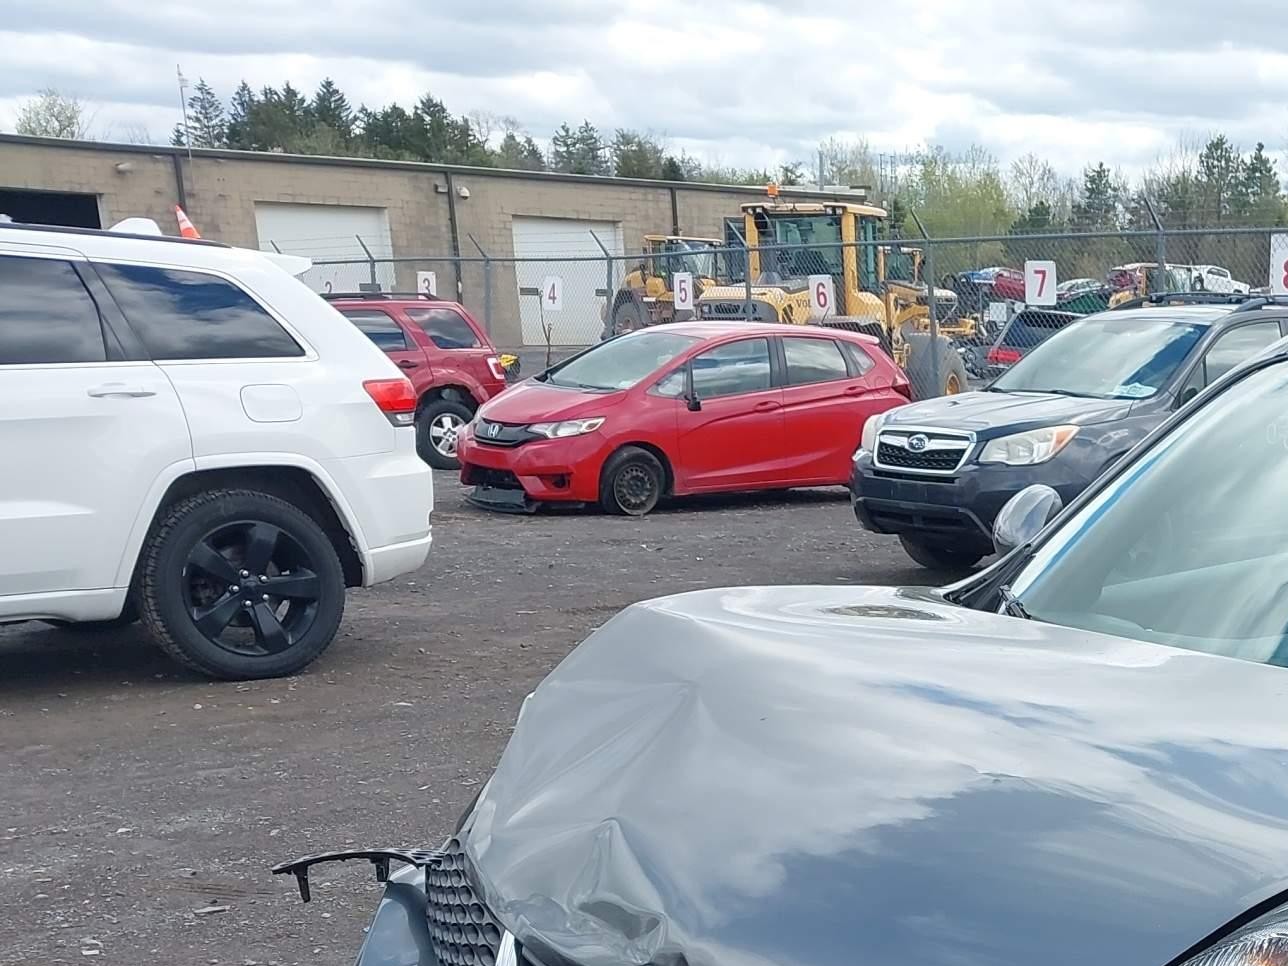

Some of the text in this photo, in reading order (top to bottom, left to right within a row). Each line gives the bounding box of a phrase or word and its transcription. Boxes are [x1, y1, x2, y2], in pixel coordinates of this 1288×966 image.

[422, 278, 432, 294] 3
[547, 283, 557, 304] 4
[679, 279, 688, 303] 5
[816, 282, 828, 308] 6
[1033, 269, 1047, 298] 7
